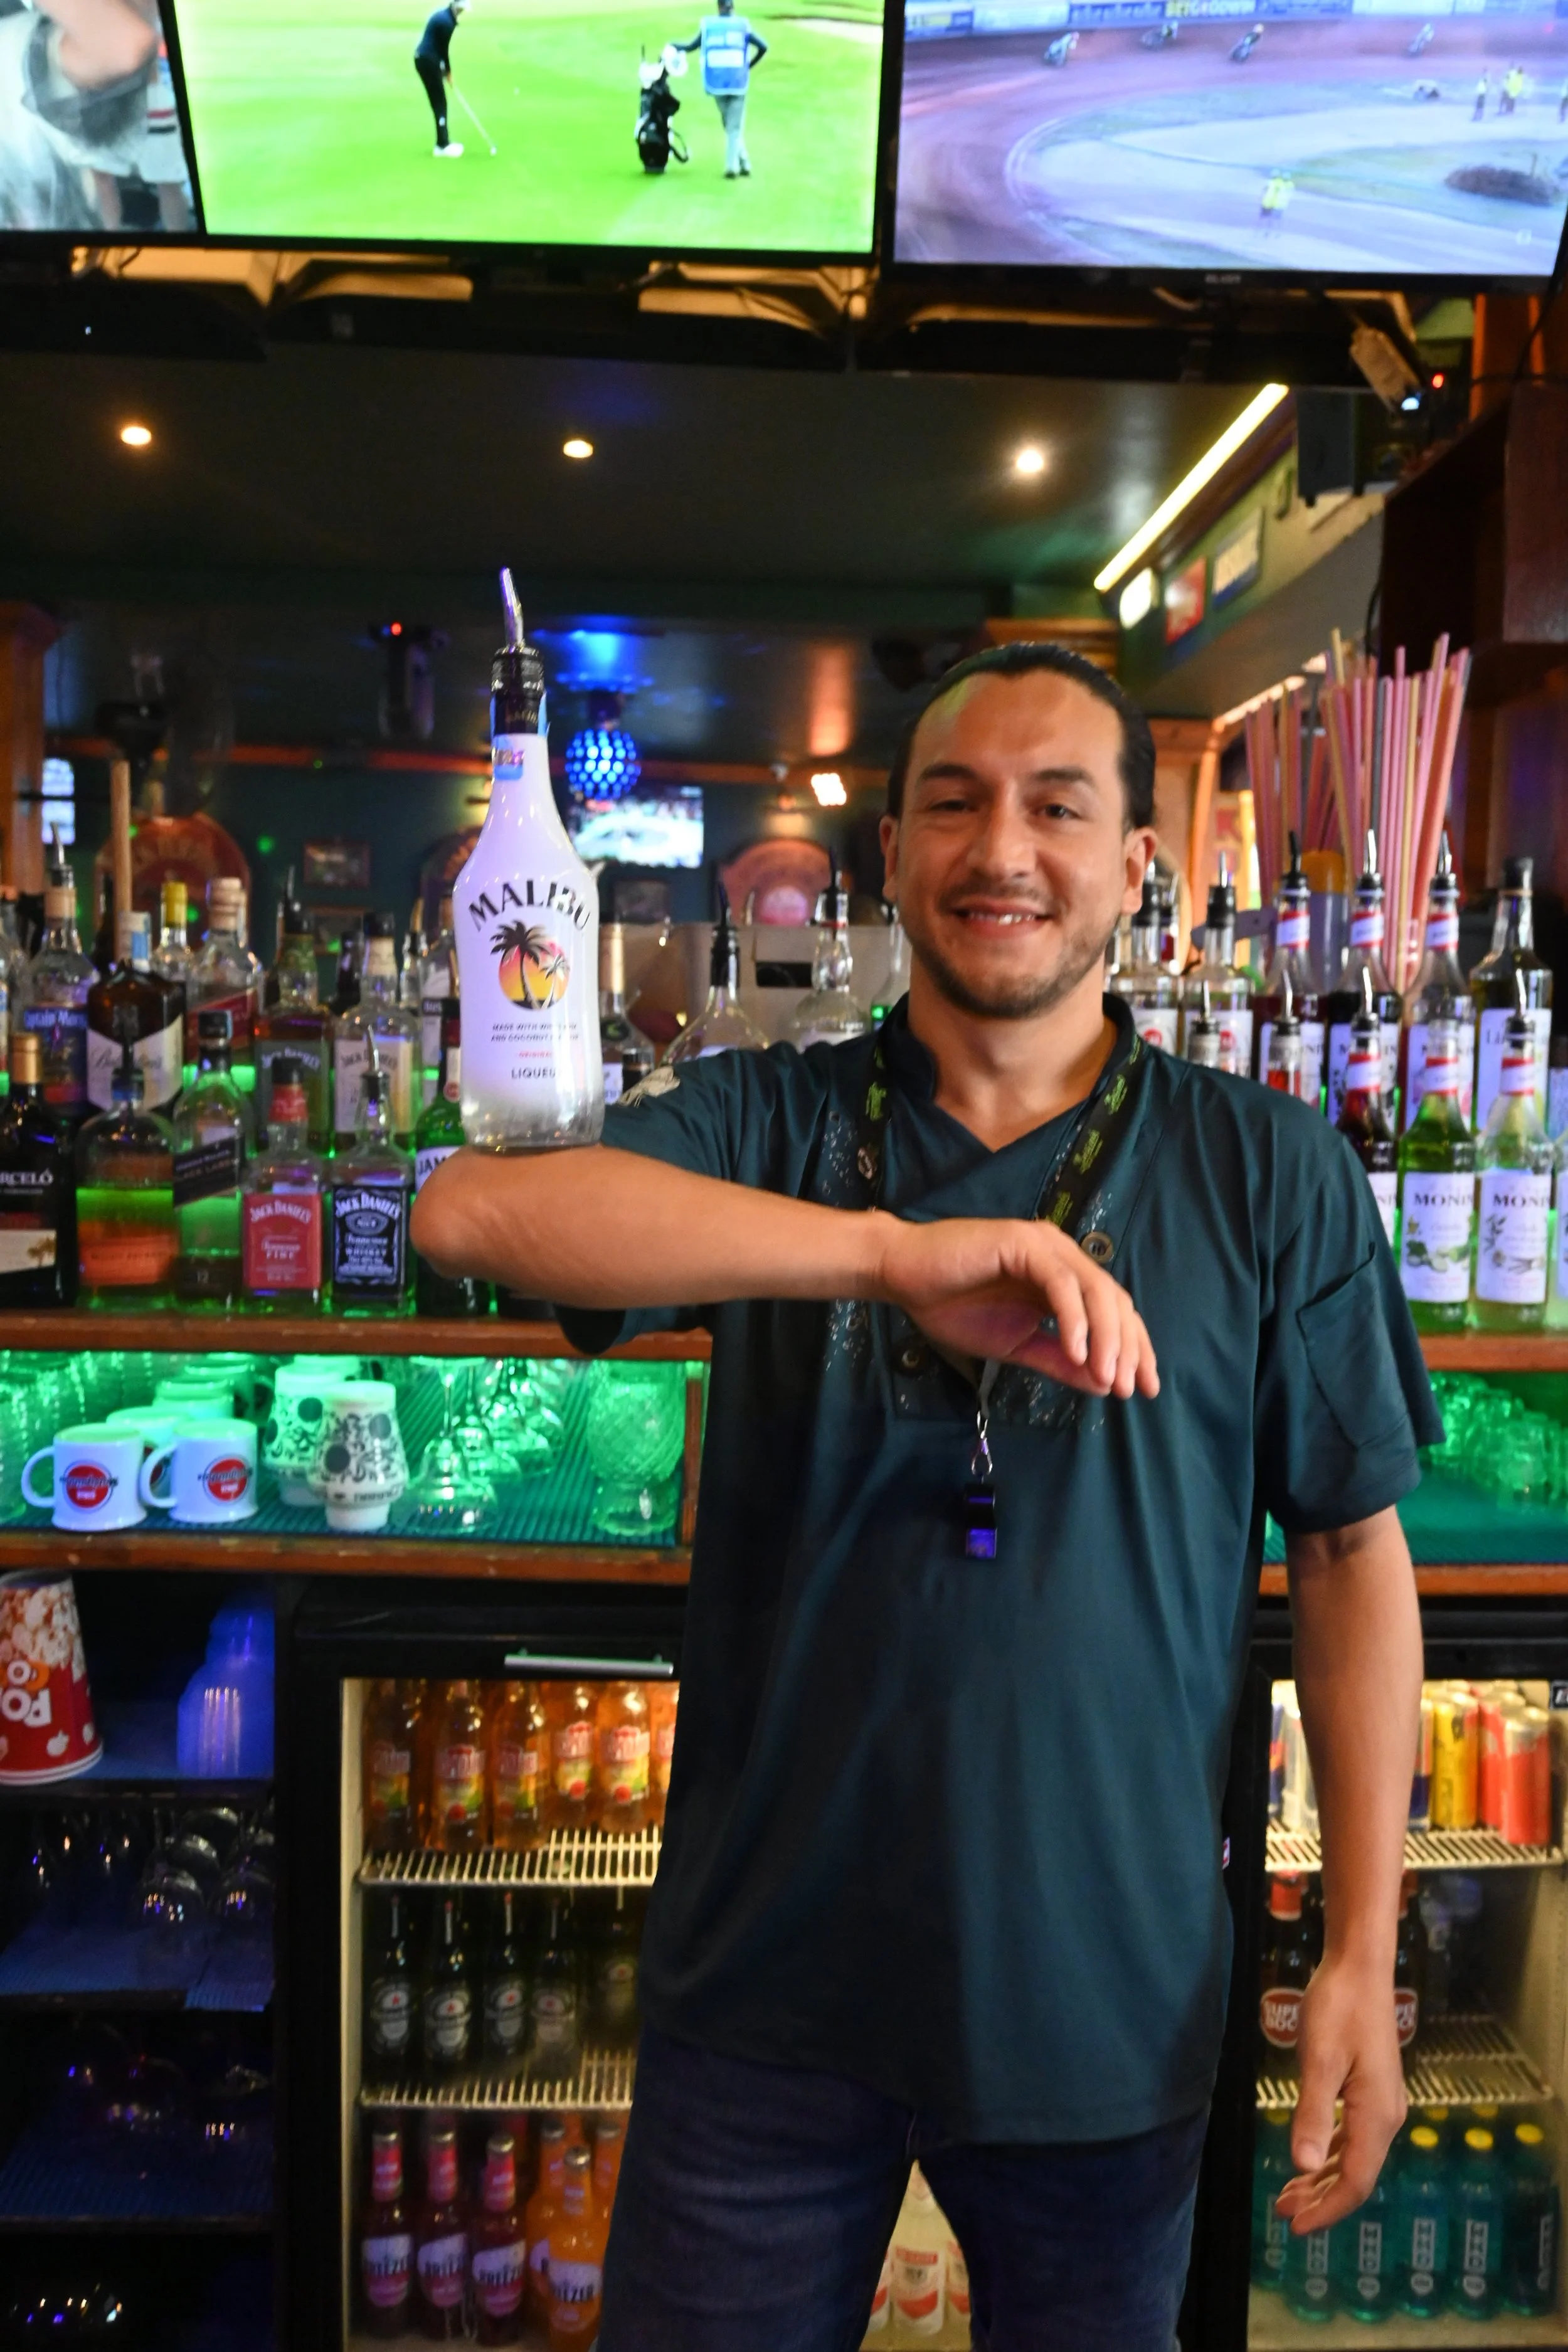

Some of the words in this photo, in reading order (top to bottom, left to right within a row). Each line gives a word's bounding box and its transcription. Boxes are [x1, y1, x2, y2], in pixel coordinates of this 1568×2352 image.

[469, 879, 591, 933] MALIBU
[511, 1067, 556, 1079] LIQUEU
[250, 1204, 273, 1222] JACK
[335, 1197, 359, 1218] JACK
